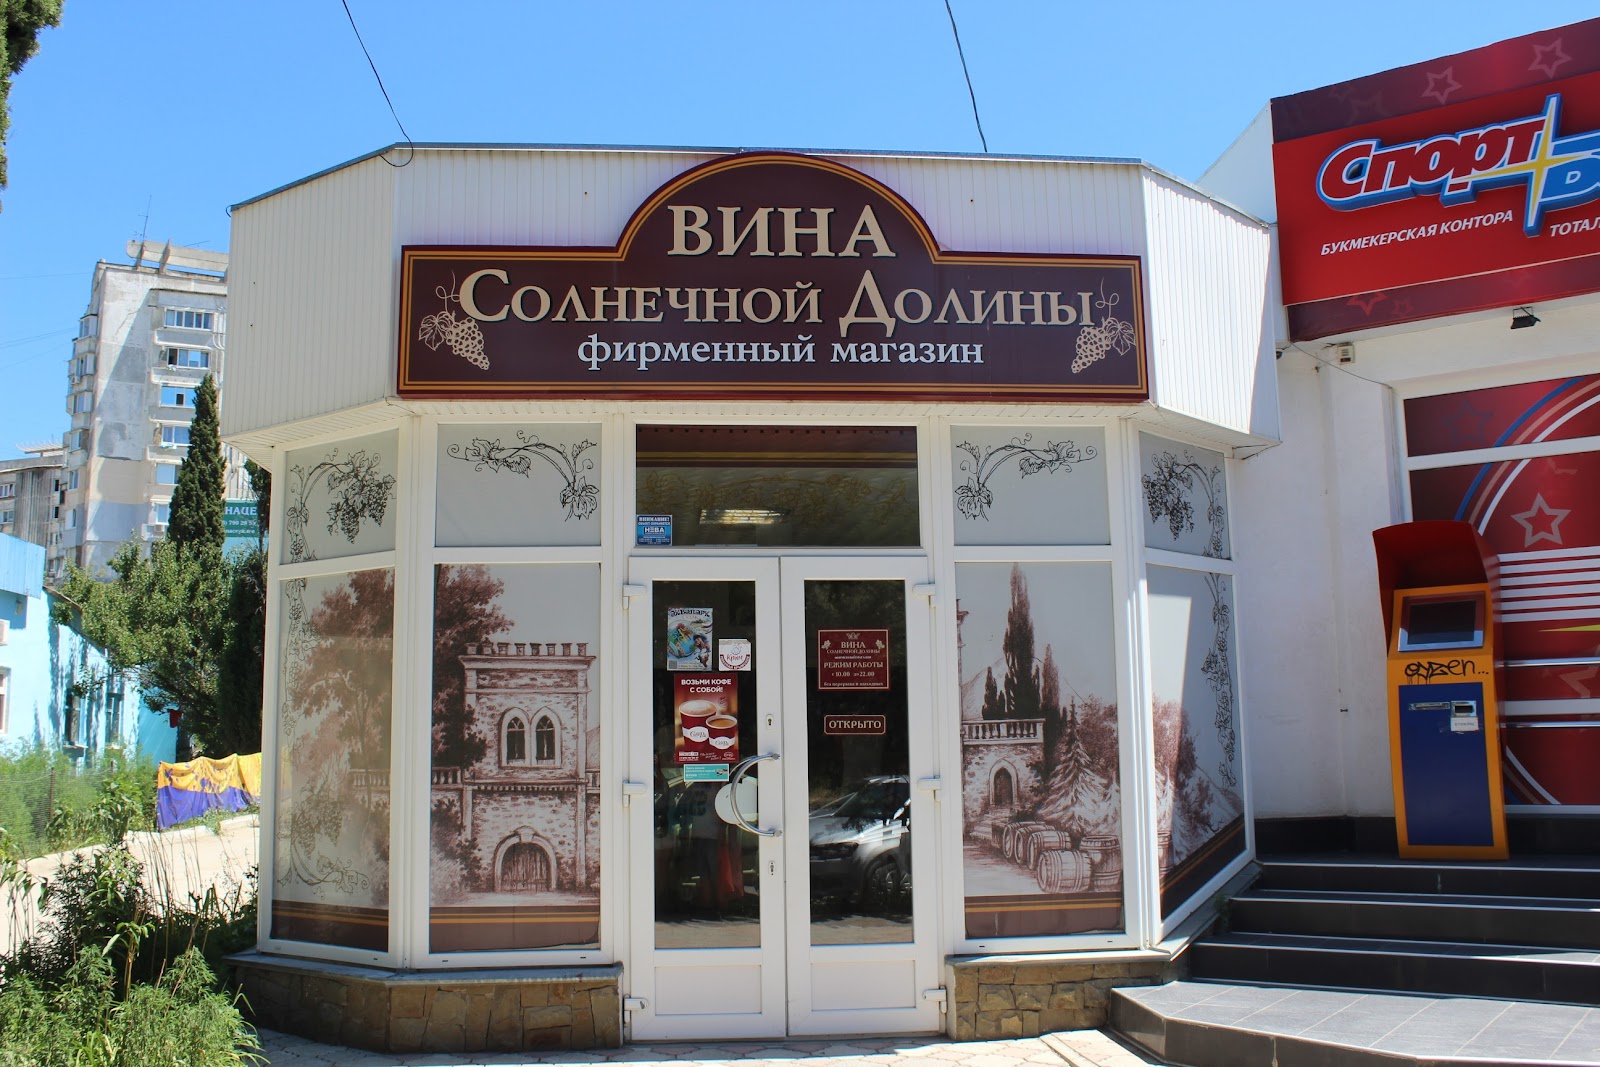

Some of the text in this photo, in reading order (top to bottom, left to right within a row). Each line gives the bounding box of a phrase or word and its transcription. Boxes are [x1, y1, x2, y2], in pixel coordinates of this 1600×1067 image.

[667, 204, 897, 258] ВИНА
[1320, 210, 1514, 256] БУКМЕКЕРСКАЯ КОНТОРА
[577, 332, 984, 371] фирменный магазин
[841, 641, 866, 649] ВИНА
[828, 720, 882, 729] ОТКРЫТО
